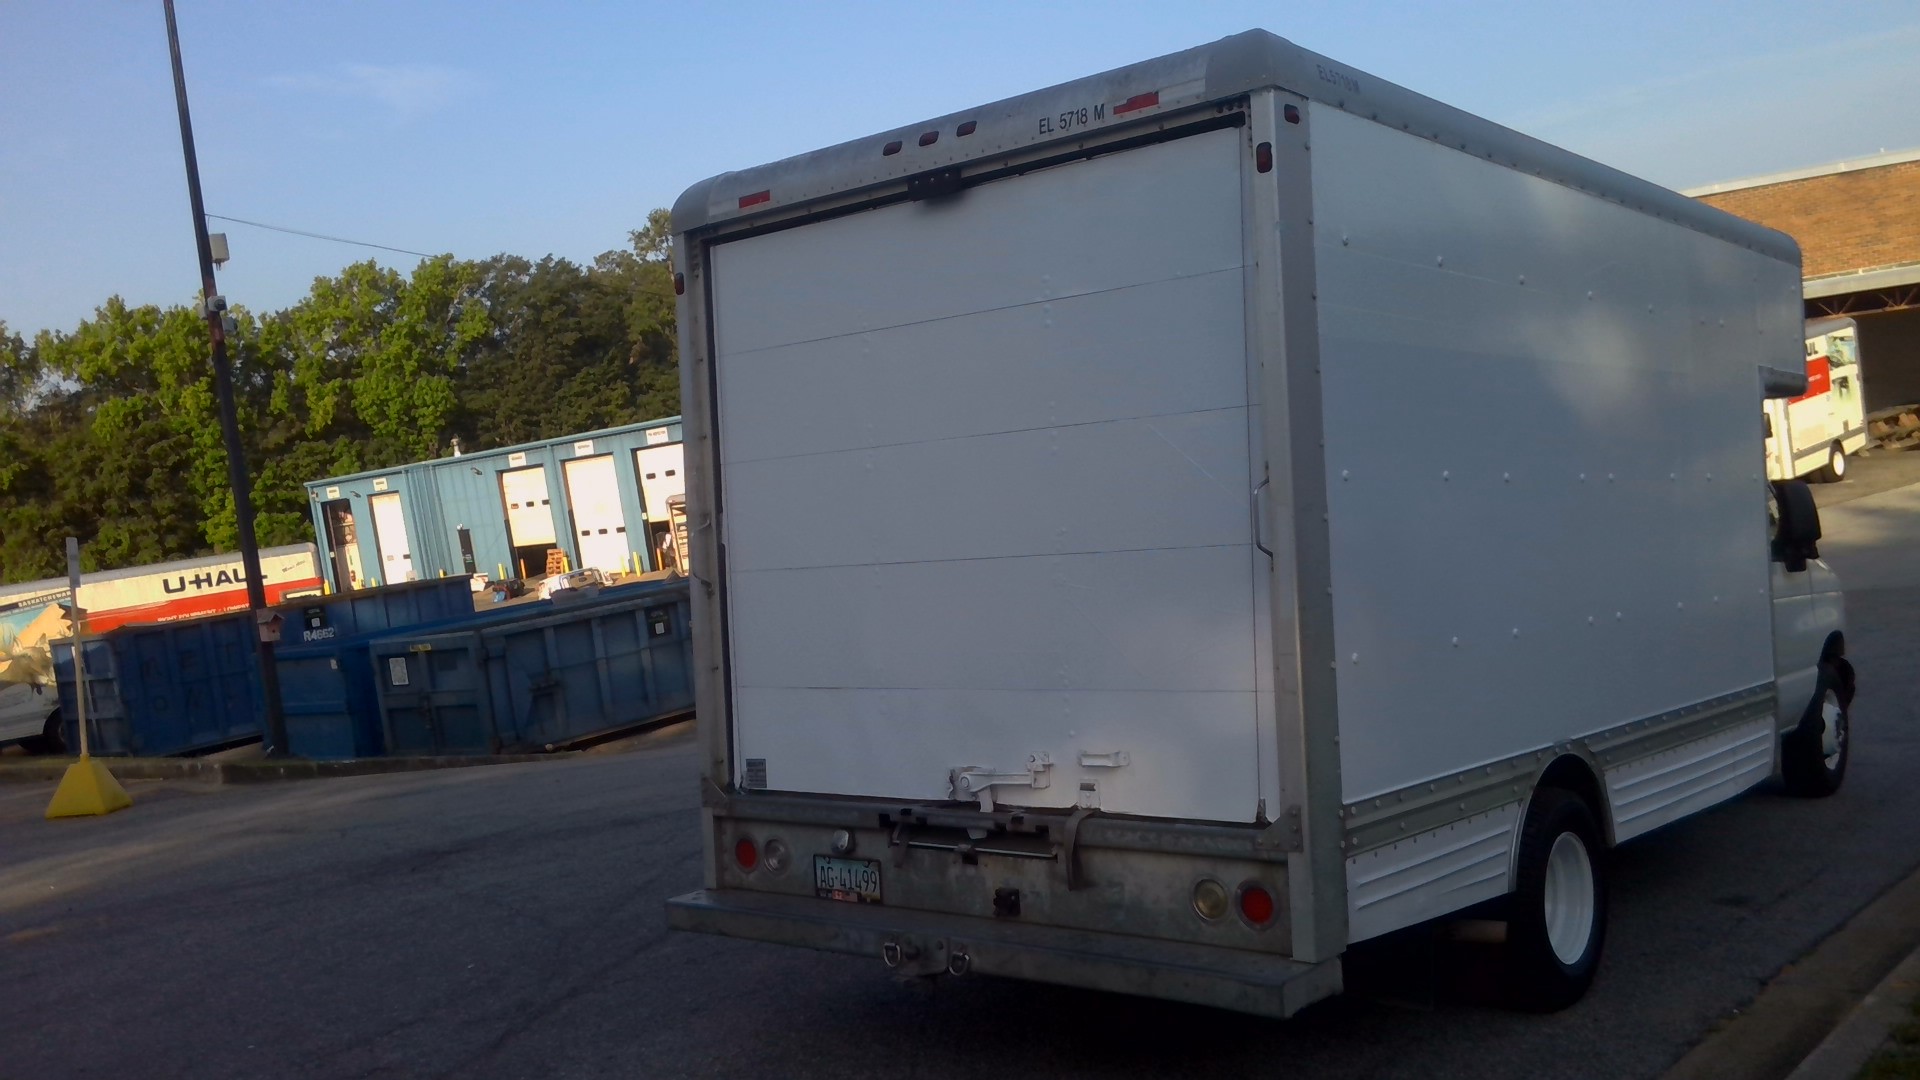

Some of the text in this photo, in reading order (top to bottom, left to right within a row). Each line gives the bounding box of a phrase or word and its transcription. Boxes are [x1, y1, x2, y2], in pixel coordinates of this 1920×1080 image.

[1039, 103, 1105, 134] EL 5718 M
[163, 568, 268, 594] U-HAU
